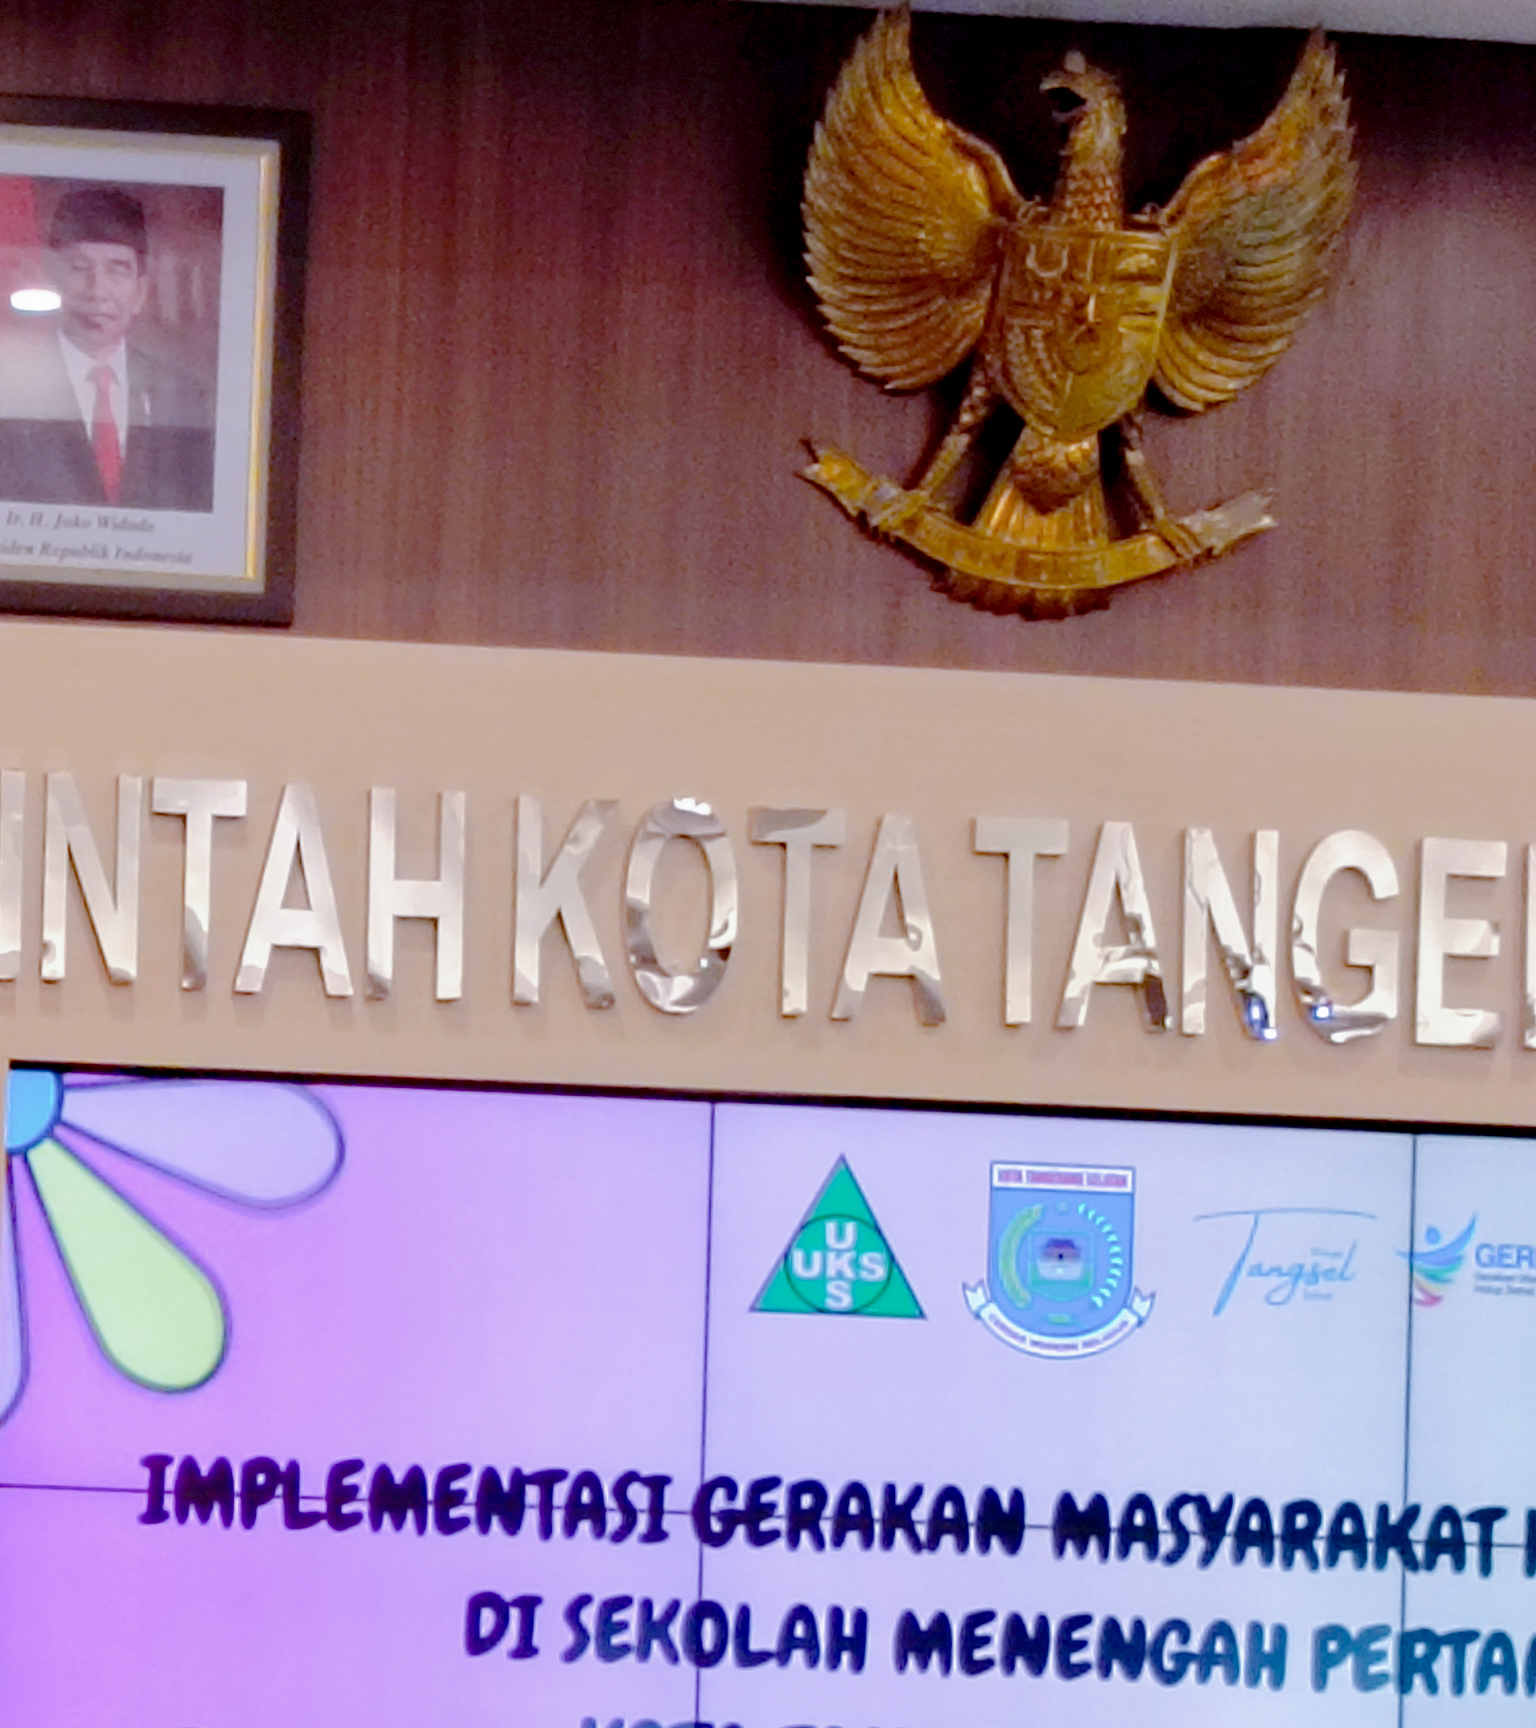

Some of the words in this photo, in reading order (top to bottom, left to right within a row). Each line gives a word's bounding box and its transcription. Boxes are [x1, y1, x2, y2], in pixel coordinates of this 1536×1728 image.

[512, 793, 946, 1028] KOTA
[972, 817, 1536, 1048] TANGE
[792, 1250, 886, 1280] UKS
[138, 1453, 673, 1544] IMPLEMENTASI
[692, 1474, 1025, 1557] GERAKAN
[1053, 1491, 1507, 1577] MASYARAKAT
[464, 1590, 543, 1660] DI
[560, 1593, 867, 1675] SEKOLAH
[894, 1608, 1288, 1691] MENENGAH
[1310, 1622, 1536, 1698] PERTA
